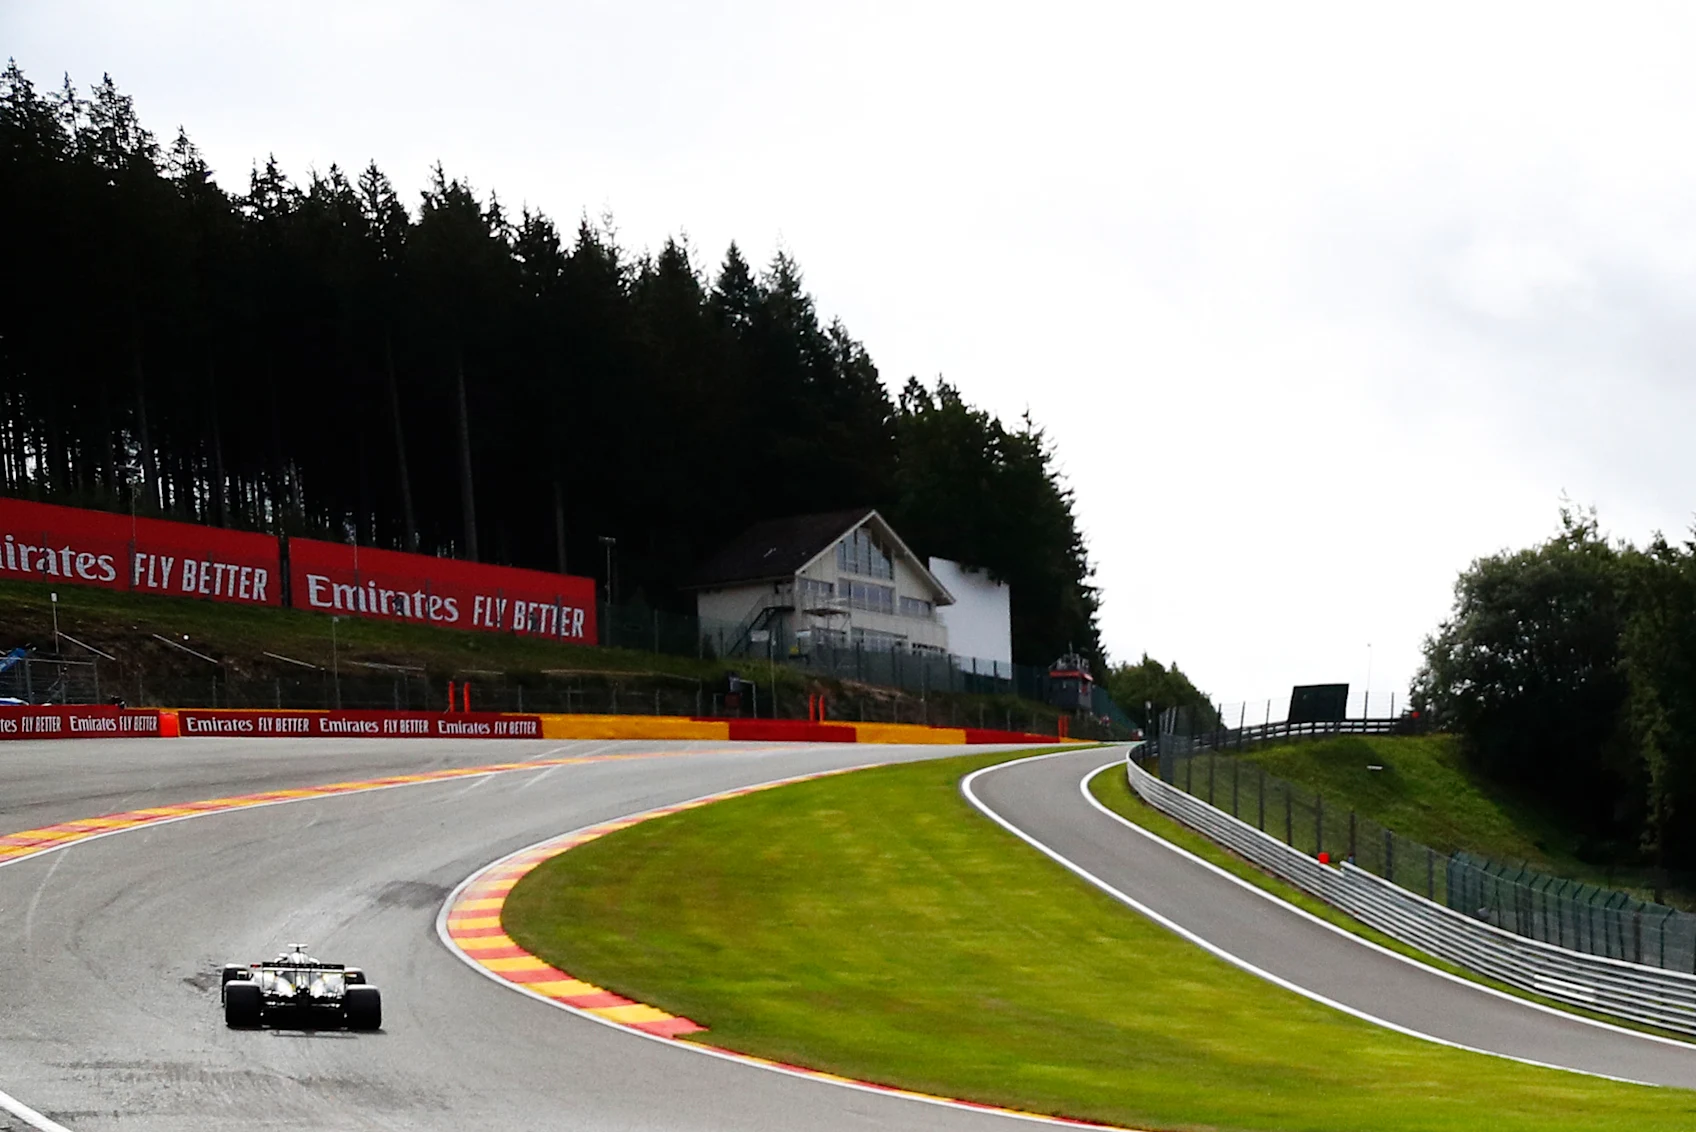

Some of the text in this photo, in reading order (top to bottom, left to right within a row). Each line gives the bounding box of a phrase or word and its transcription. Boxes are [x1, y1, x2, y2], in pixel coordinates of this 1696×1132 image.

[0, 534, 268, 602] irates FLY BETTER
[306, 573, 460, 623] Emirates
[473, 594, 508, 628] FLY
[21, 716, 34, 733] FLY
[36, 716, 62, 733] BETTER
[69, 715, 158, 732] Emirates FLY BETTER
[186, 716, 310, 733] Emirates FLY BETTER
[319, 717, 430, 734] Emirates FLY BETTER
[437, 720, 537, 735] Emirates FLY BETTER
